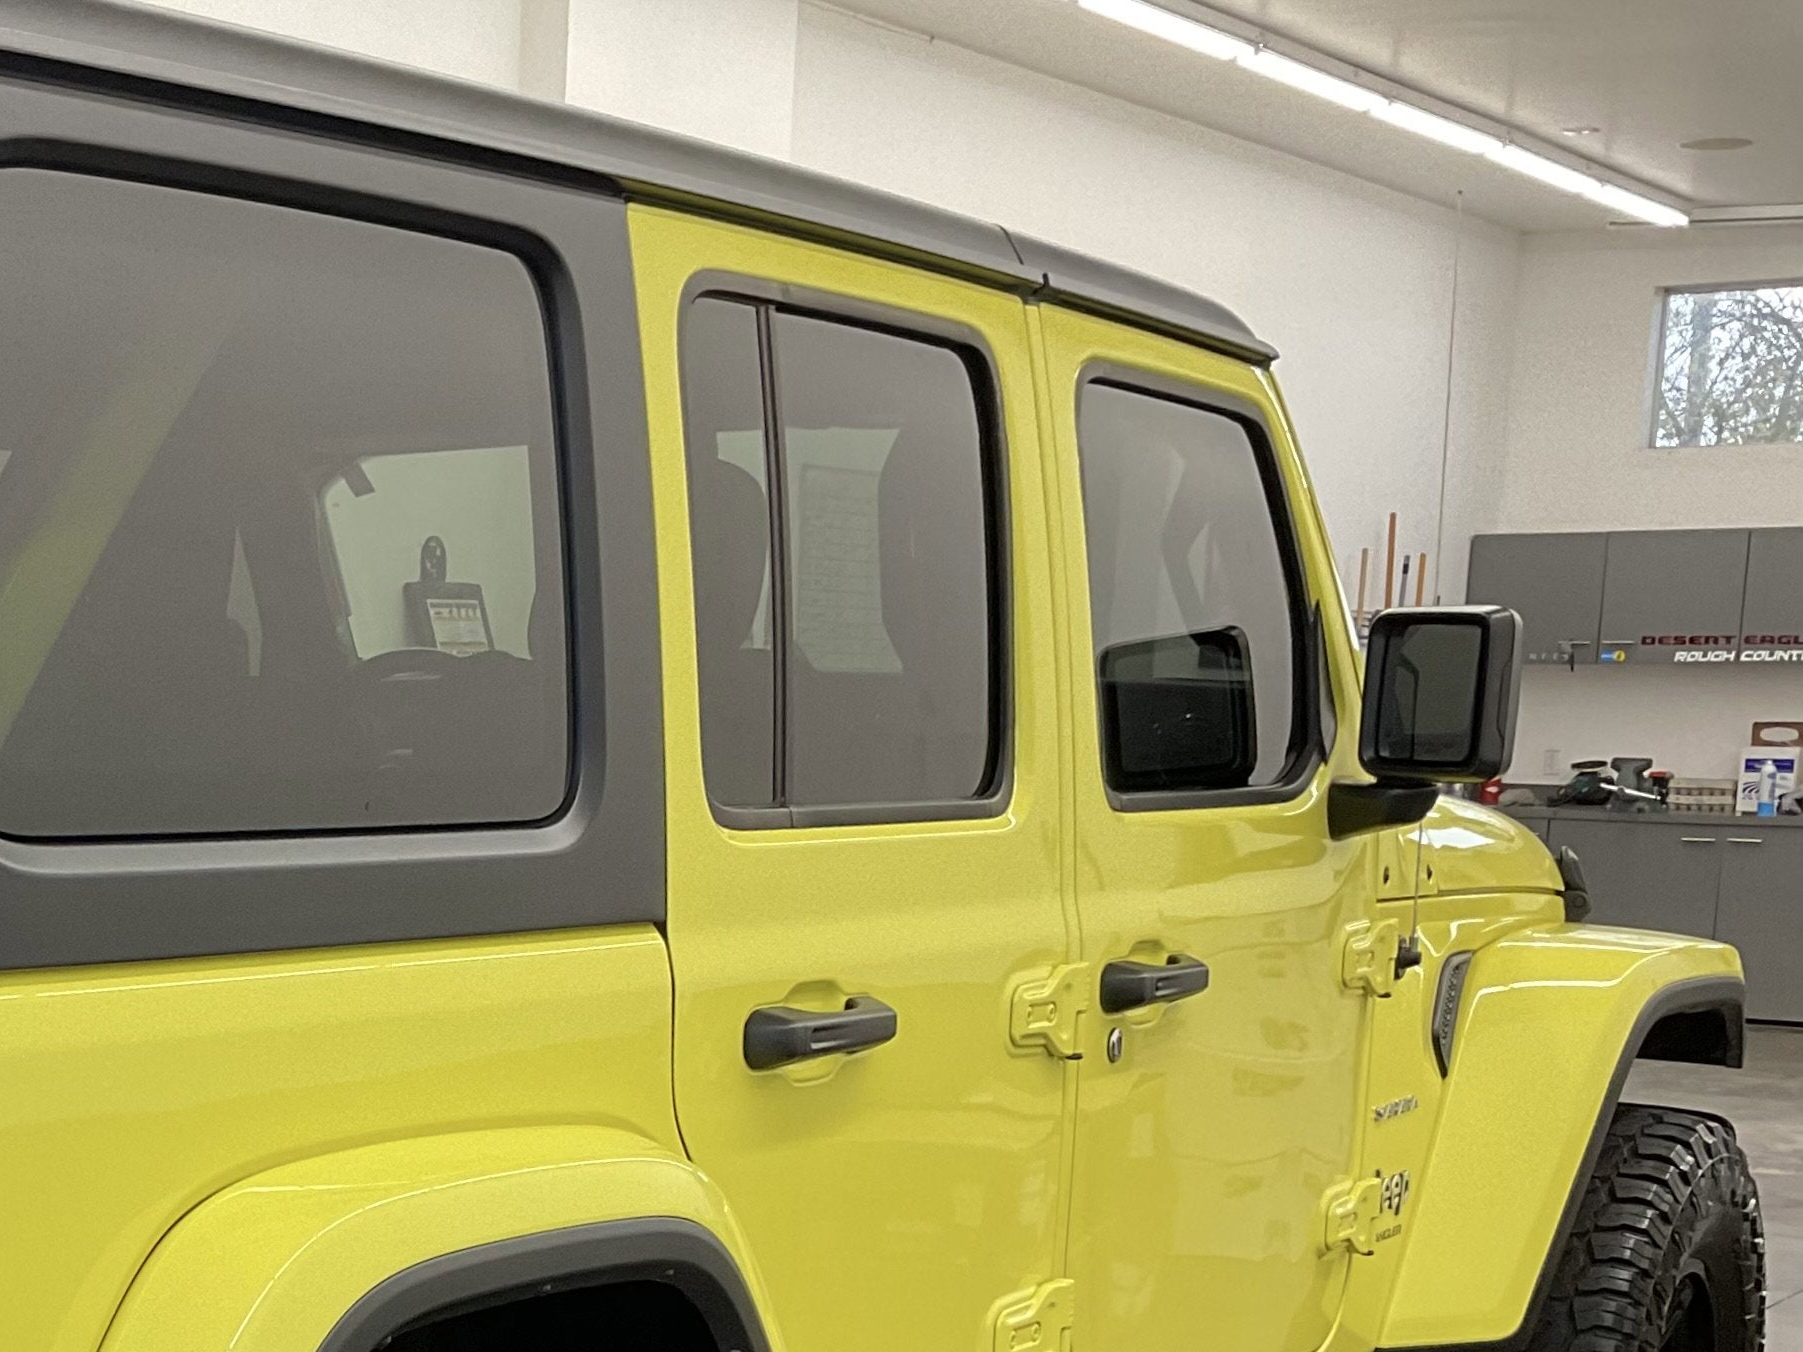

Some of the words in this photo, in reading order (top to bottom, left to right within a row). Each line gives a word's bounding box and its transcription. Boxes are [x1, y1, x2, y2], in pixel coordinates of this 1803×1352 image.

[1641, 635, 1737, 646] DESERT
[1673, 651, 1737, 662] ROUGH
[1739, 650, 1803, 662] COUNT
